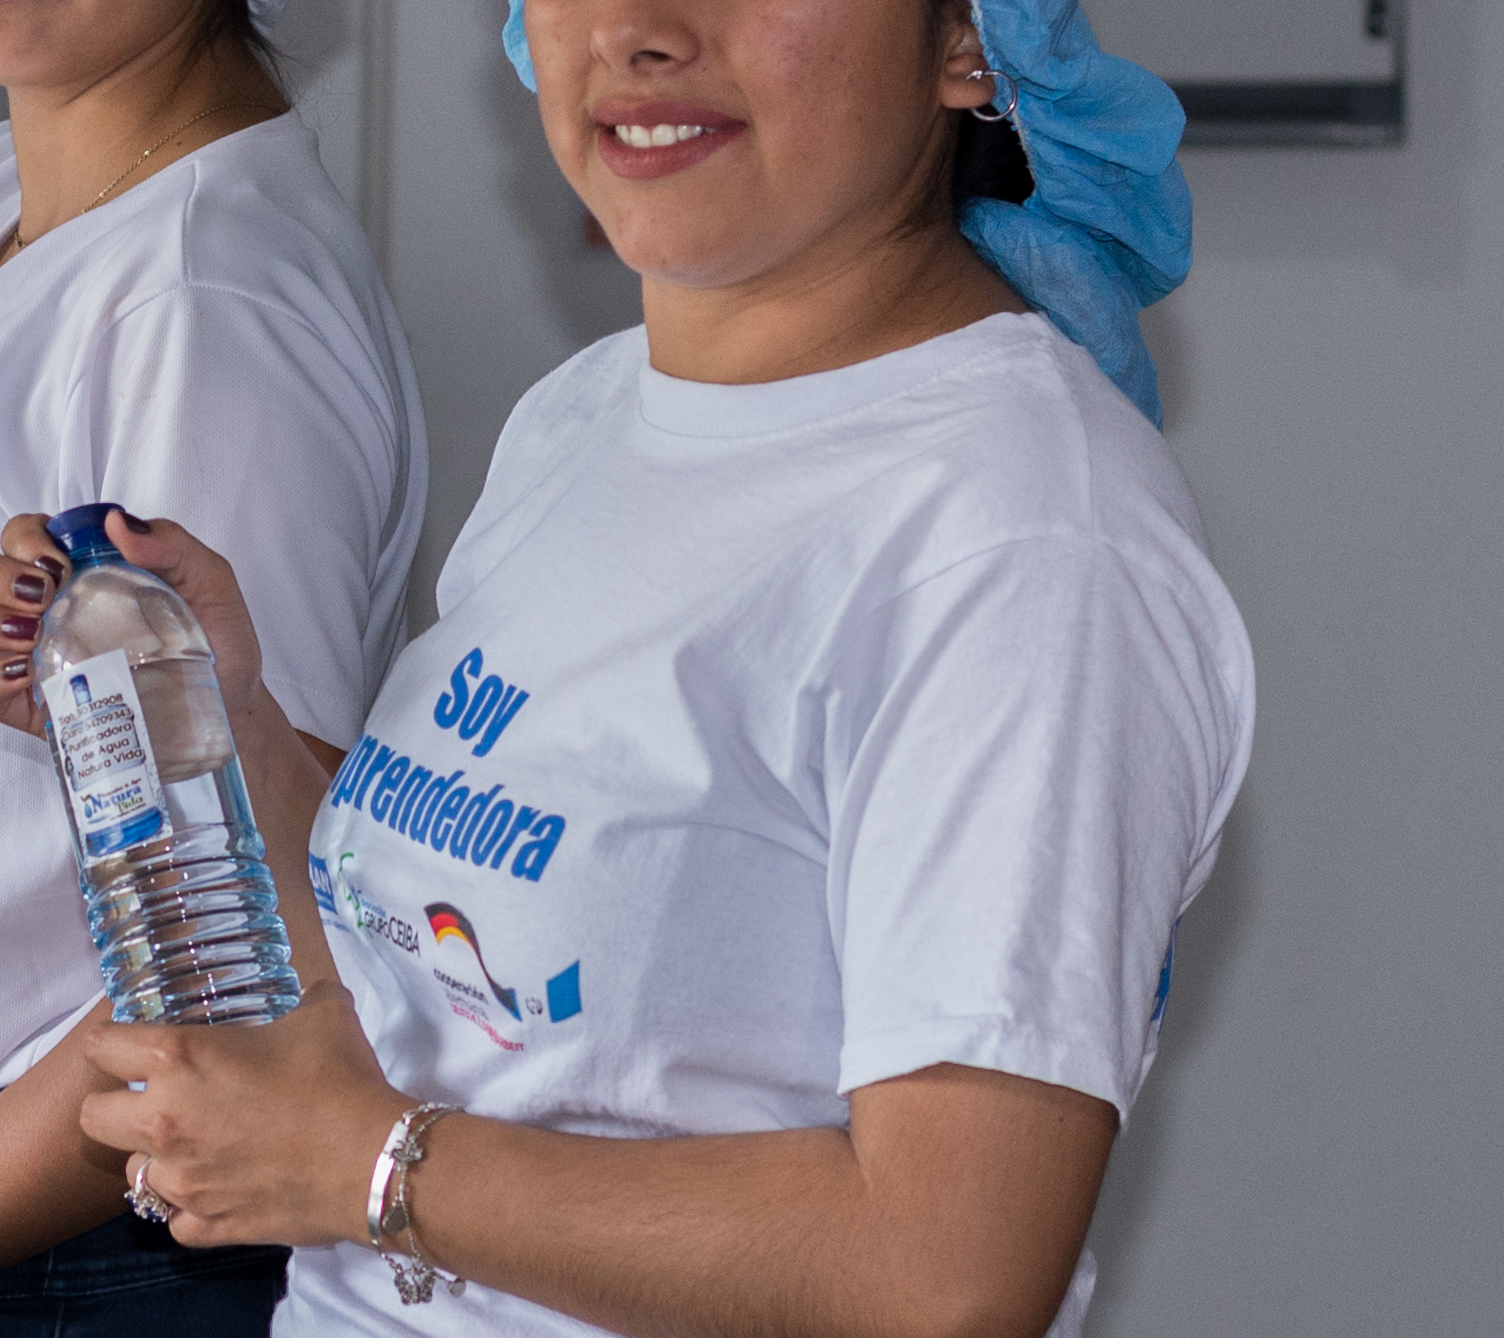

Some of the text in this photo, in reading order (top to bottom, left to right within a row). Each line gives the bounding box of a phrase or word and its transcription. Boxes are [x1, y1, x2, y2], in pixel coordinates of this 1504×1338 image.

[434, 647, 530, 758] Soy
[62, 725, 84, 743] Claro
[68, 722, 133, 754] Purificadora
[77, 748, 144, 780] Natura Vida
[81, 737, 131, 763] de Agua
[90, 785, 143, 814] Natura
